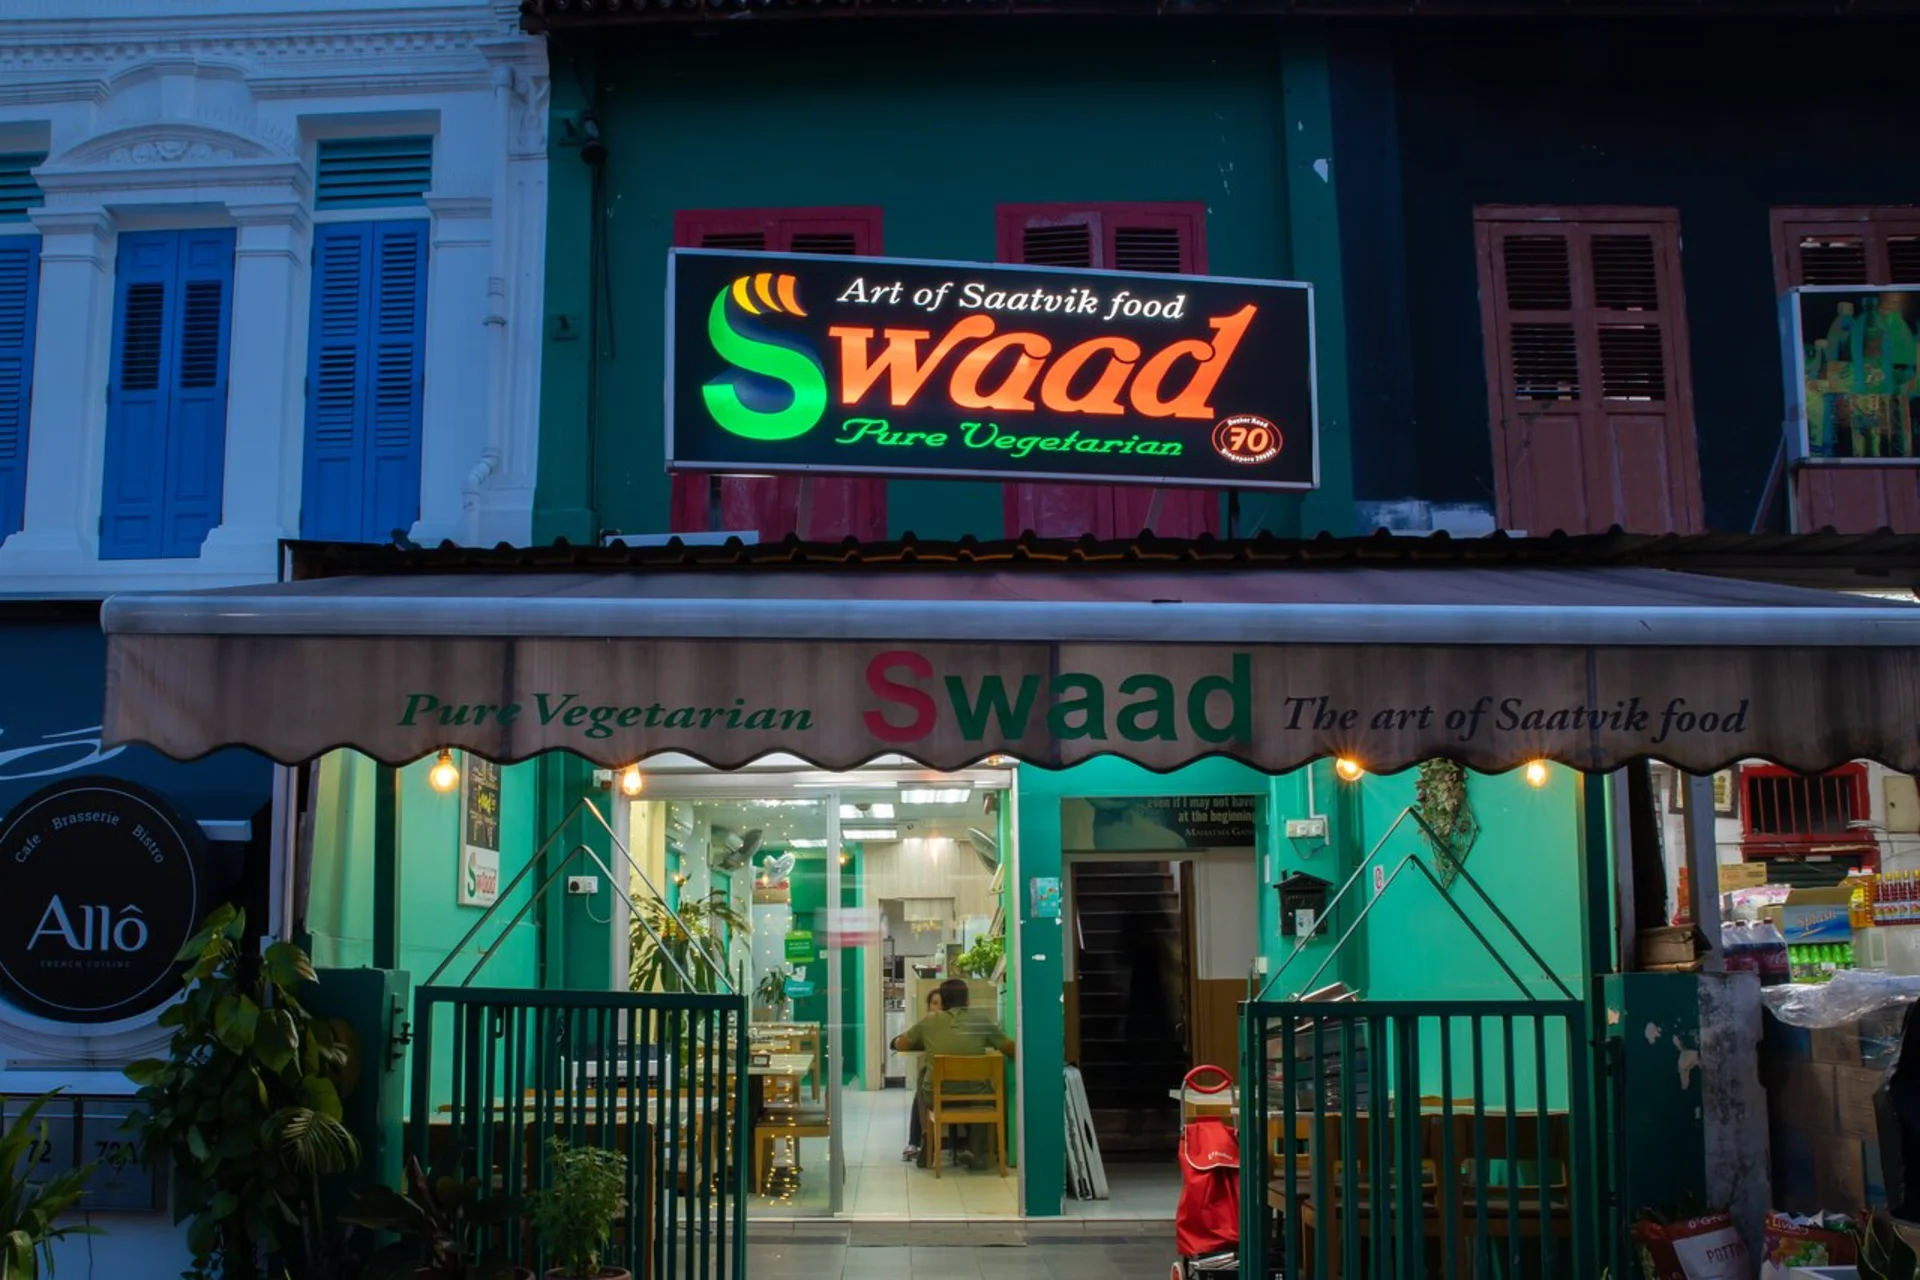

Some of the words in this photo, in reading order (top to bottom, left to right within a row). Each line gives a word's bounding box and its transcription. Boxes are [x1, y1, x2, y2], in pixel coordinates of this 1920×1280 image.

[837, 277, 903, 305] Art
[913, 282, 953, 312] of
[959, 283, 1098, 314] Saatvik
[1103, 290, 1186, 321] food
[702, 273, 1258, 441] Swaad
[835, 418, 948, 447] Pure
[960, 422, 1183, 458] Vegetarian
[1230, 427, 1269, 452] 70
[397, 693, 522, 728] Pure
[531, 693, 814, 740] Vegetarian
[861, 650, 1253, 744] Swaad
[1284, 696, 1358, 731] The
[1370, 706, 1434, 731] art
[1445, 694, 1493, 742] of
[1496, 697, 1650, 733] Saatvik
[1653, 698, 1749, 744] food
[1178, 812, 1190, 823] at
[1192, 811, 1208, 823] the
[1189, 798, 1210, 810] may
[1213, 796, 1230, 807] not
[15, 834, 42, 863] Cafe
[51, 811, 120, 831] Brasserie
[132, 824, 164, 864] Bistro
[26, 894, 149, 952] Allô
